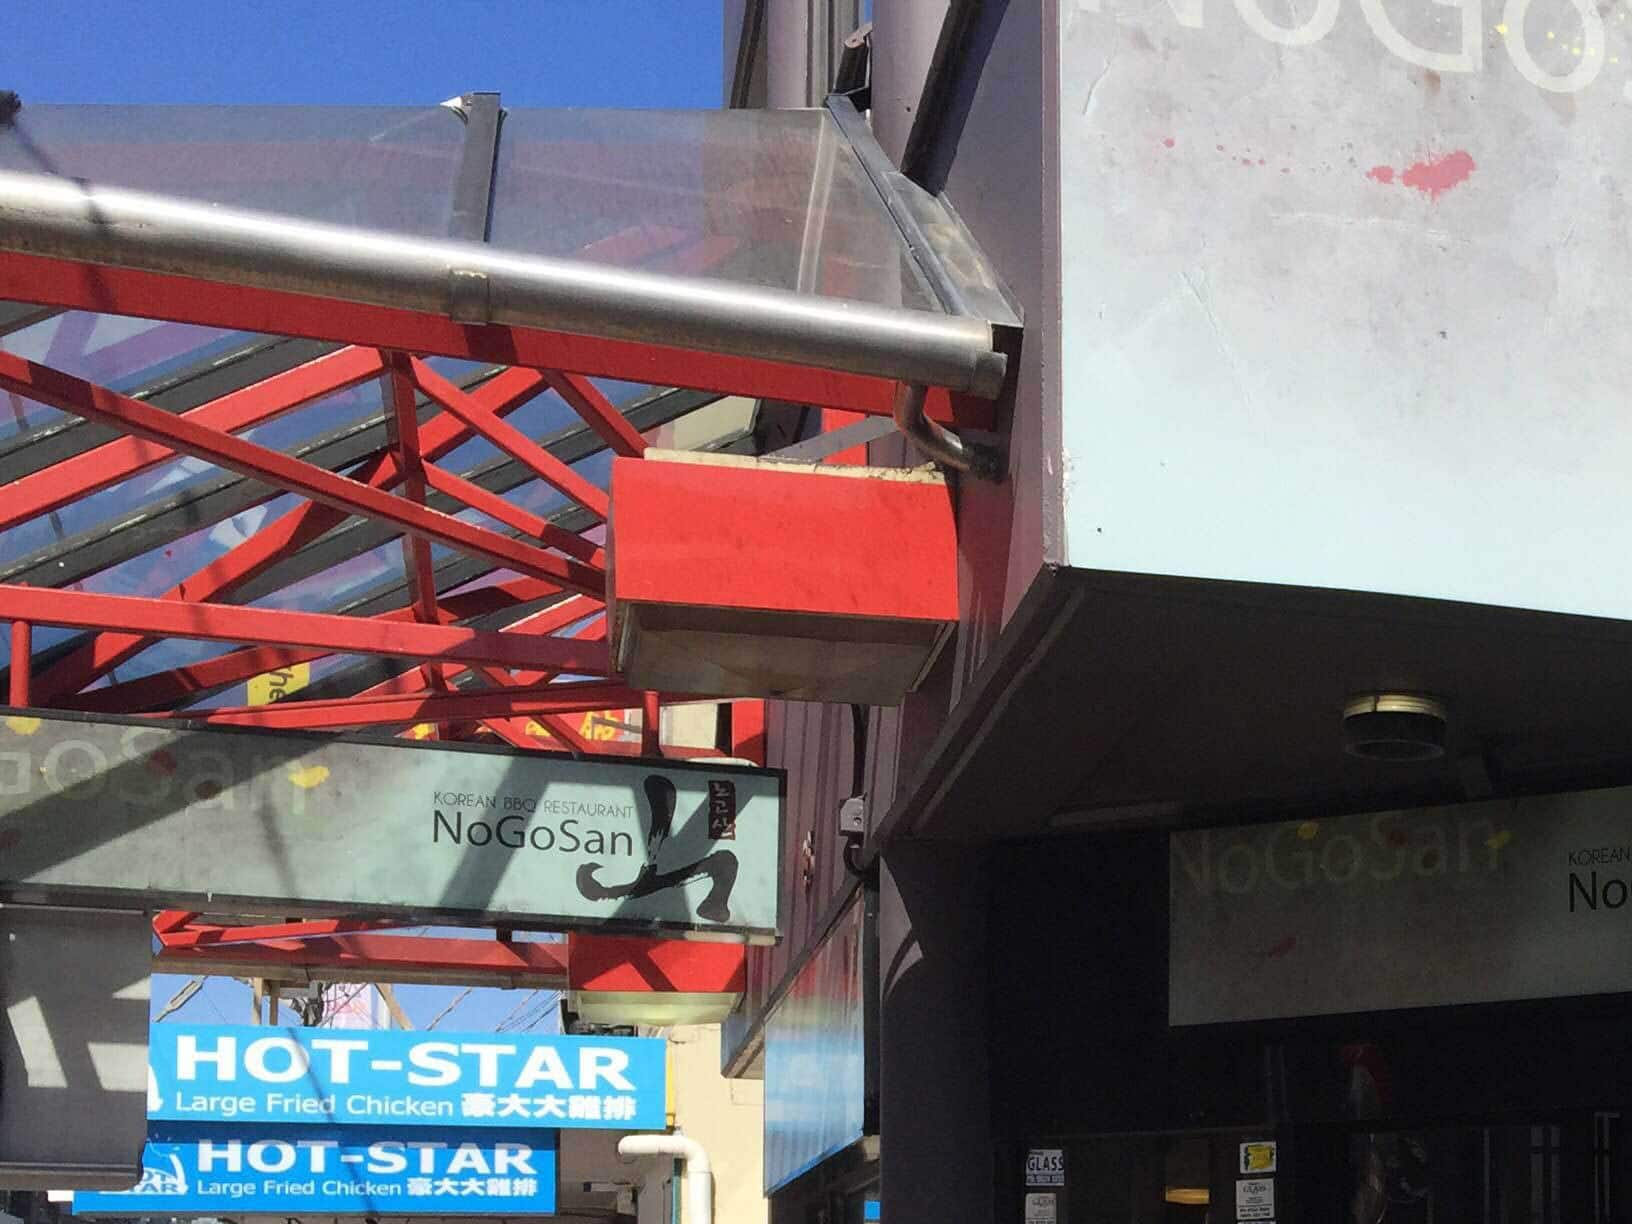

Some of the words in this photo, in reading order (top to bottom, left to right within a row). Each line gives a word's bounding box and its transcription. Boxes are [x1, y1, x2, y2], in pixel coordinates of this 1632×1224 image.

[432, 791, 497, 810] KOREAN
[503, 796, 537, 813] BBQ
[543, 799, 635, 819] RESTAURANT
[432, 809, 634, 857] NoGoSan
[1567, 847, 1631, 867] KOREAN
[175, 1034, 638, 1091] HOT-STAR
[176, 1091, 256, 1118] Large
[266, 1092, 336, 1114] Fried
[346, 1094, 454, 1117] Chicken
[197, 1138, 538, 1175] HOT-STAR
[1026, 1155, 1065, 1172] GLASS
[197, 1180, 257, 1199] Large
[263, 1180, 315, 1196] Fried
[321, 1180, 402, 1197] Chicken
